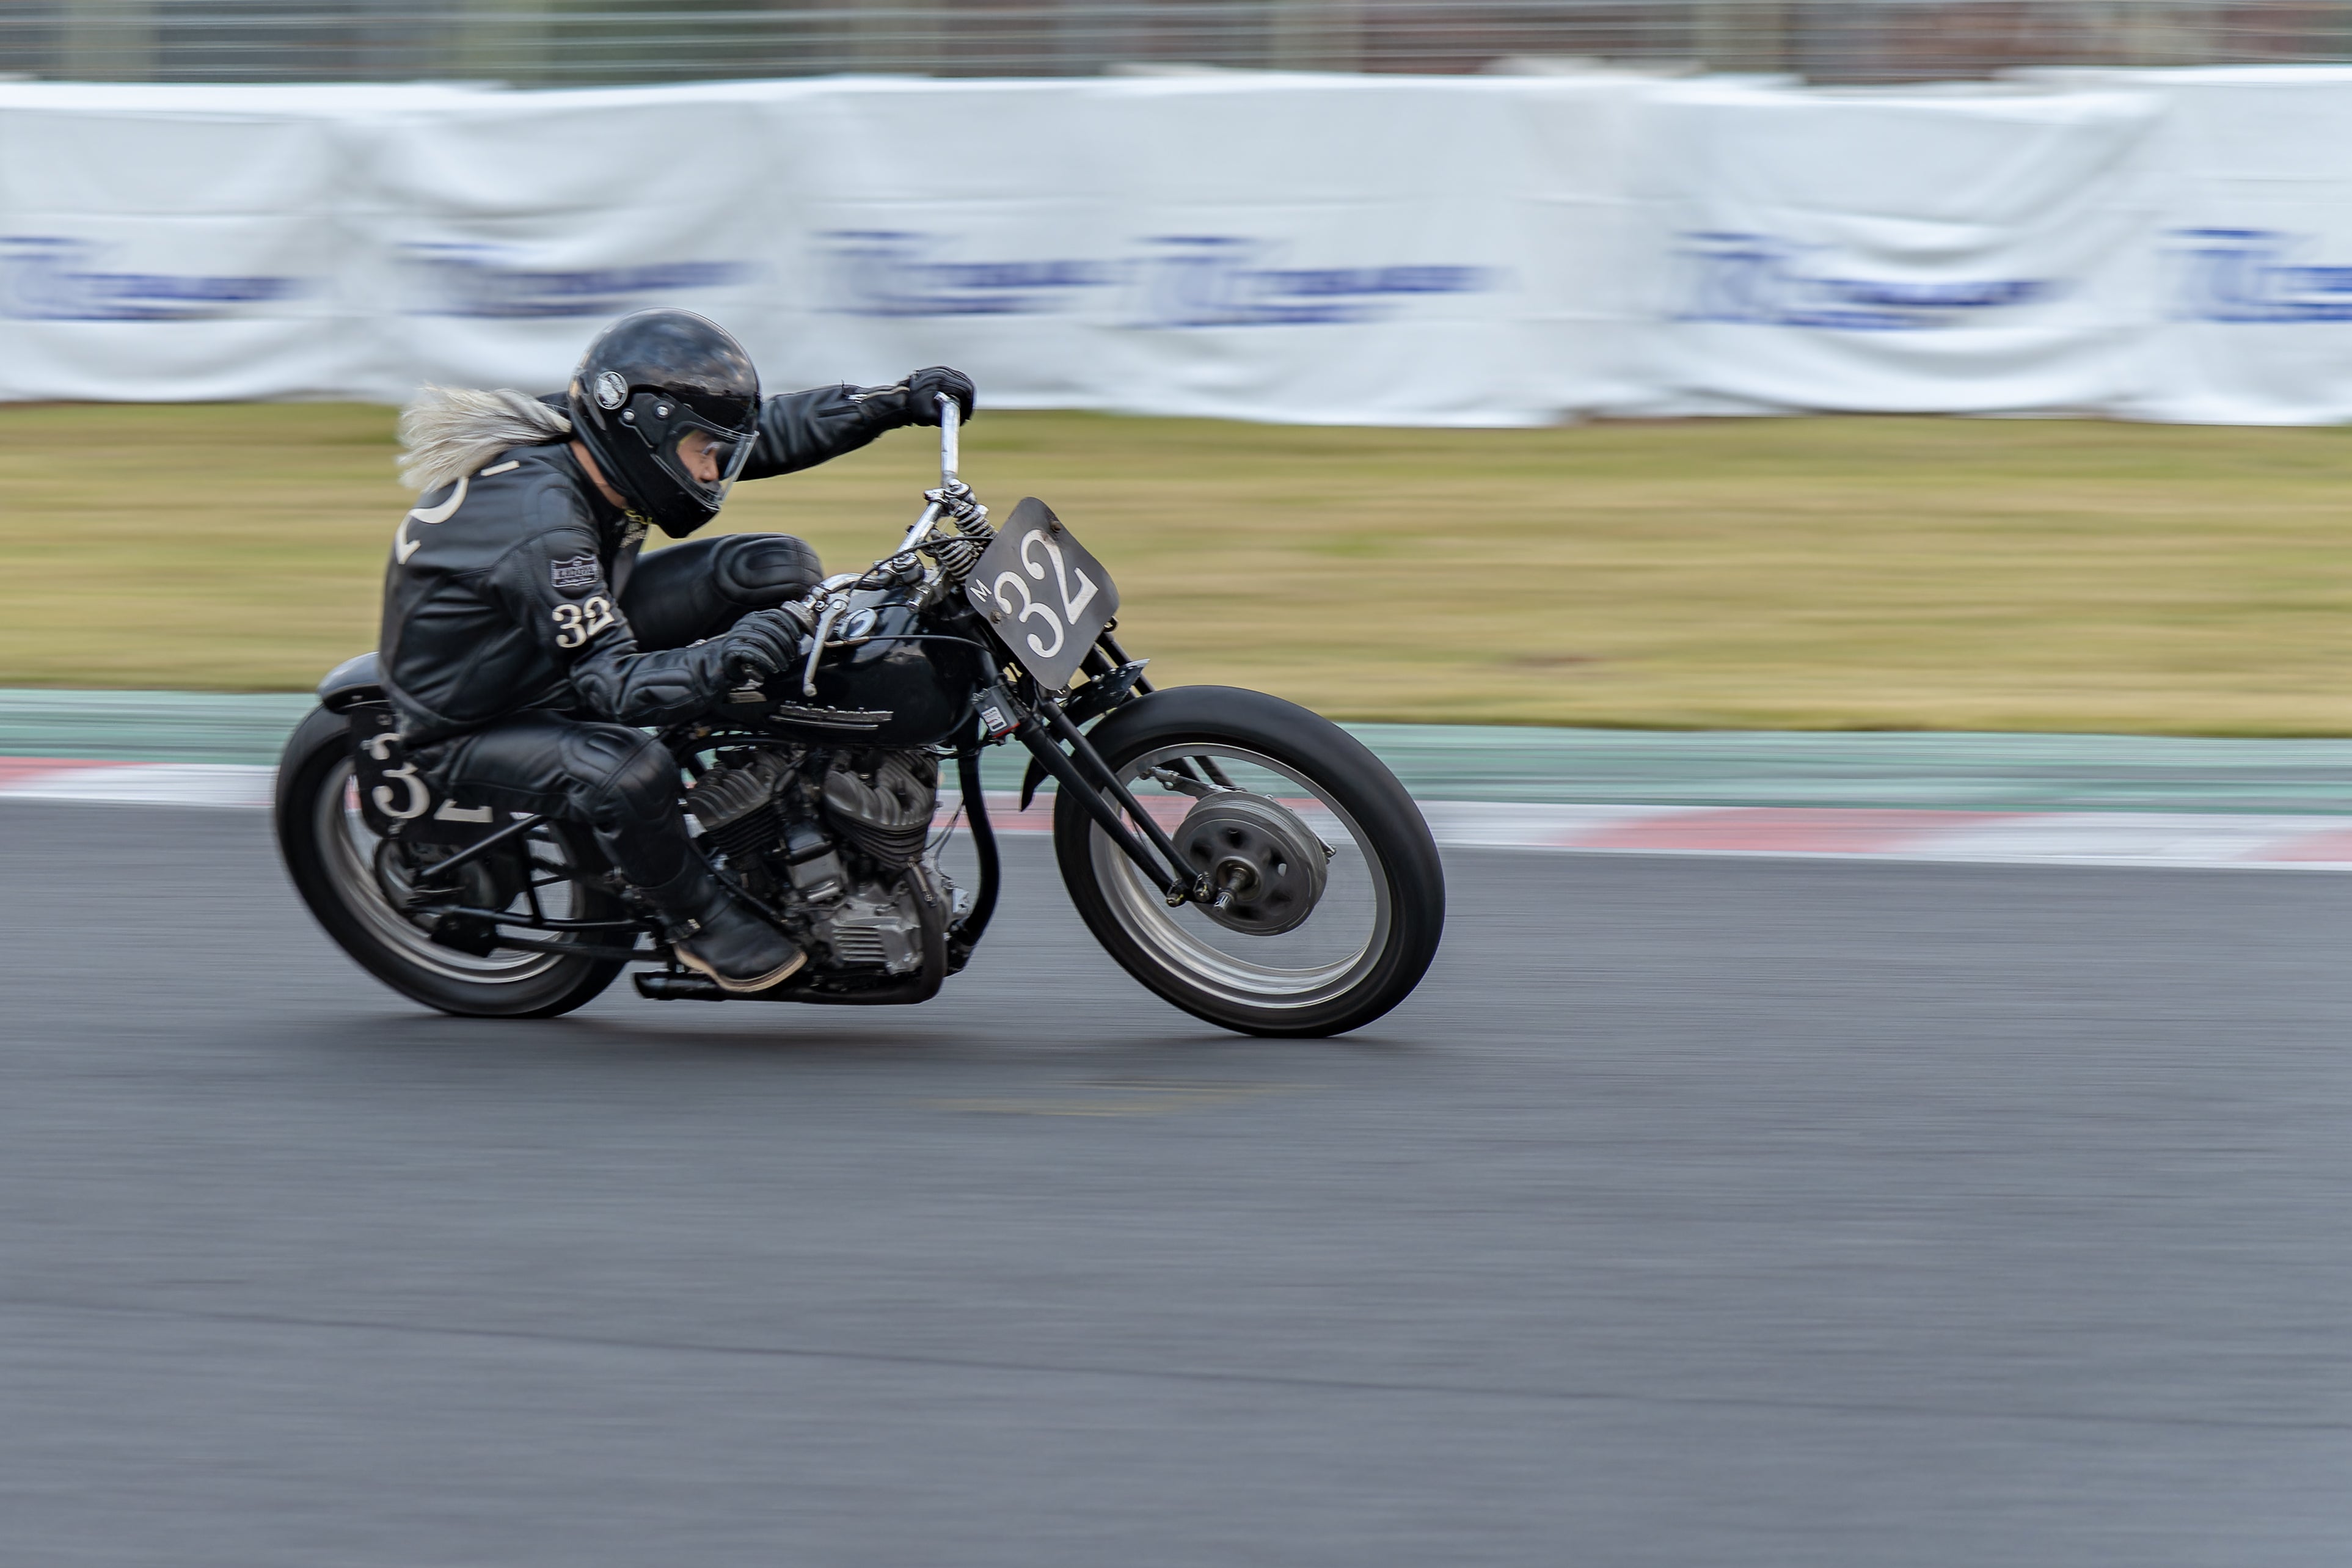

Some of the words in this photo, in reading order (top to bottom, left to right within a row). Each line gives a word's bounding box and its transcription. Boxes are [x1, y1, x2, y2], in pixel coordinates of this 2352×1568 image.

[552, 596, 615, 648] 32
[970, 578, 993, 603] M
[993, 529, 1099, 658] 32
[370, 732, 494, 823] 3
